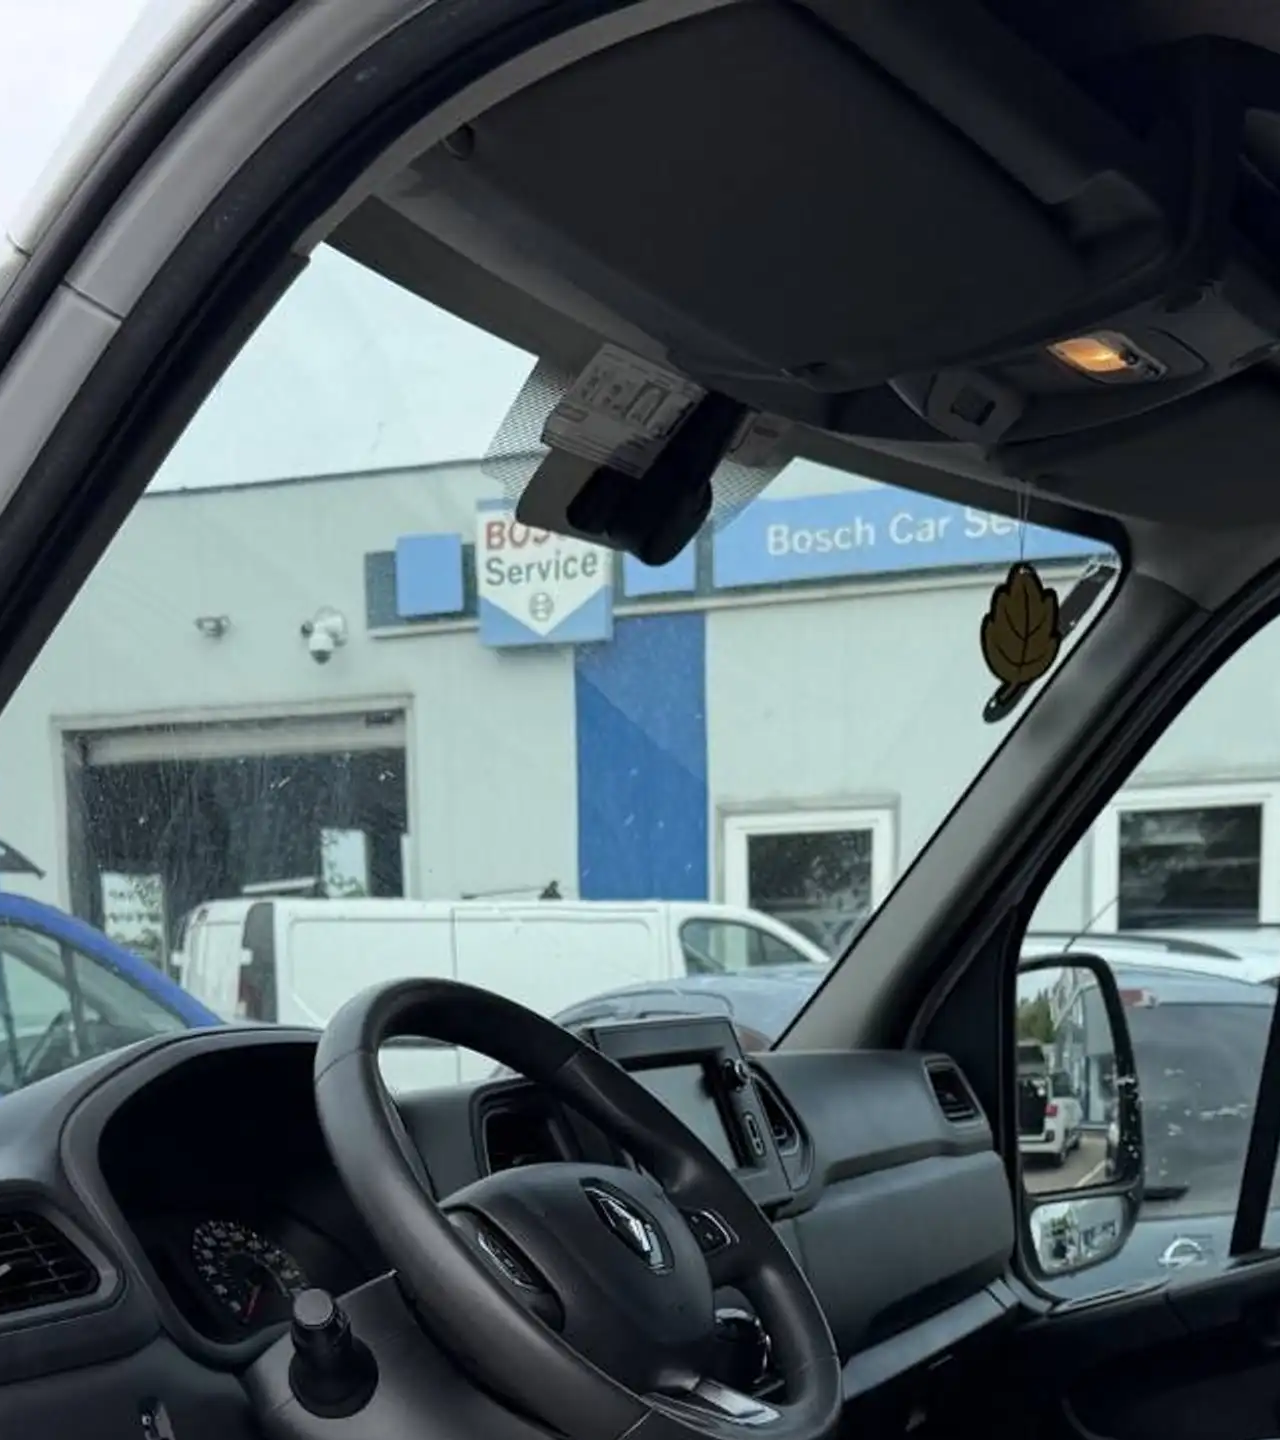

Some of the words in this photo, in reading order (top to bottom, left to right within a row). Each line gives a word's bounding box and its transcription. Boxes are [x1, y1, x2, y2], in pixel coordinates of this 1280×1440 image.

[767, 516, 875, 556] Bosch
[889, 513, 954, 545] Car
[485, 550, 598, 586] Service
